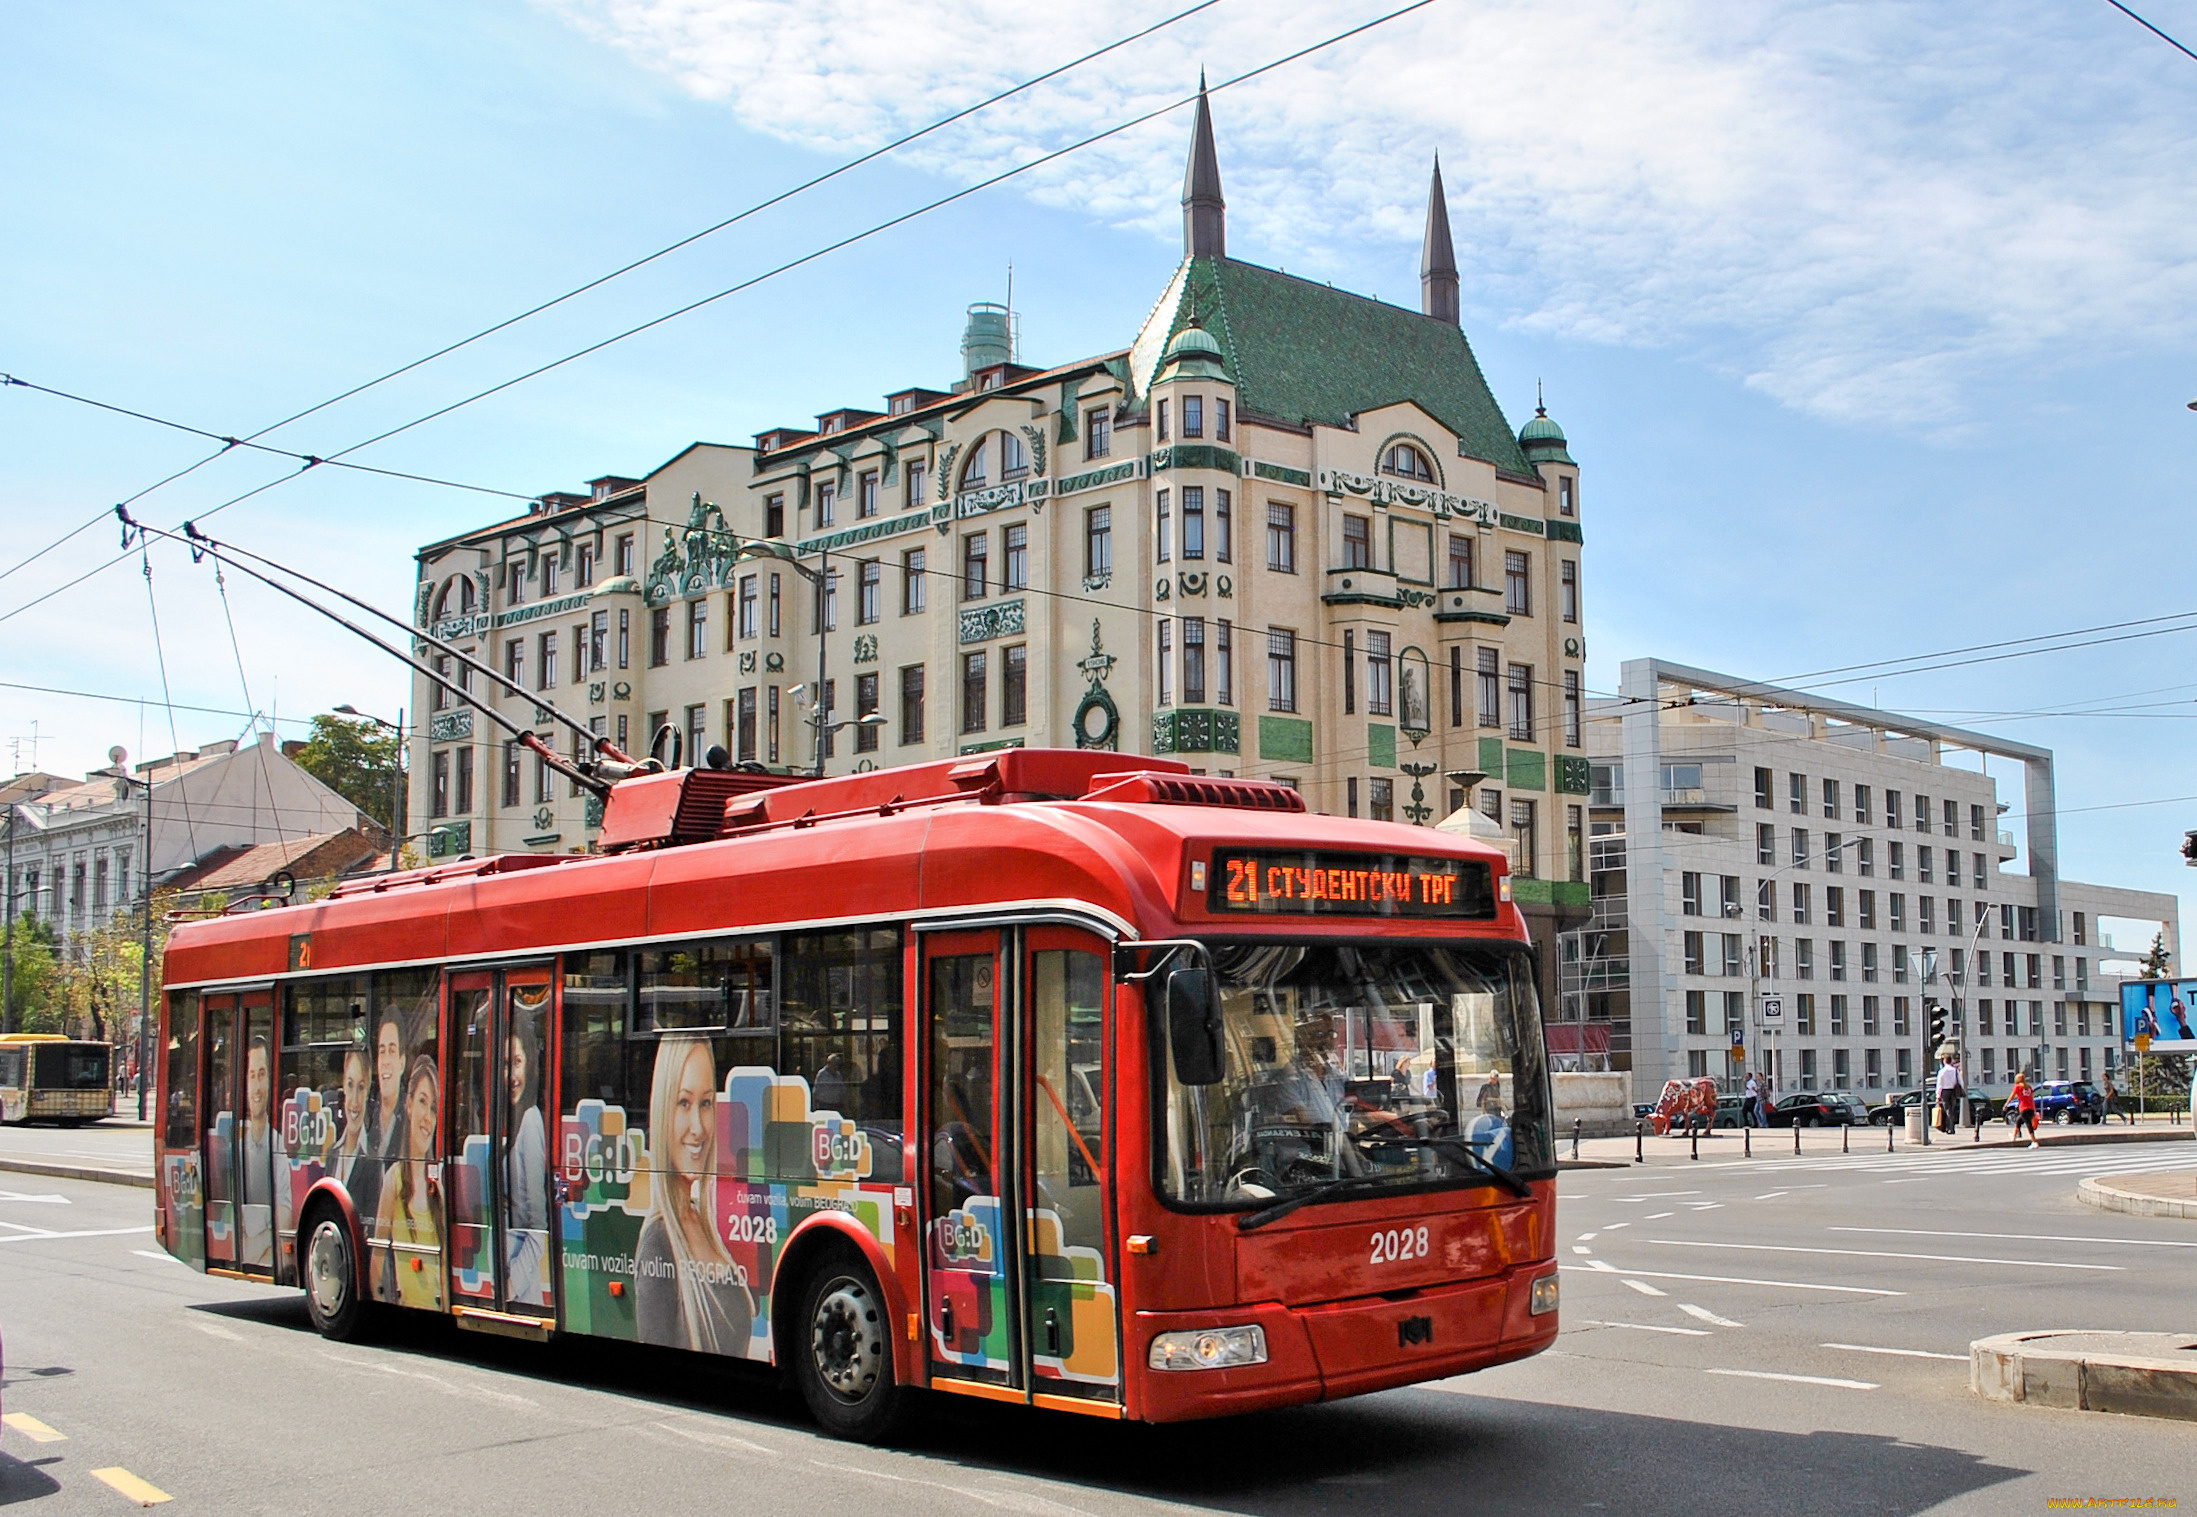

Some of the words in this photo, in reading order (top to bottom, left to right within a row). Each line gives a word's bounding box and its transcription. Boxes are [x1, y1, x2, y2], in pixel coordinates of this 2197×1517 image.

[1227, 860, 1257, 901] 21
[1267, 866, 1411, 902] СТУДЕНТСКИ
[1419, 874, 1457, 904] ТРГ
[1734, 1030, 1741, 1043] P
[2138, 1019, 2146, 1031] P
[288, 1111, 327, 1146] BG:D
[566, 1133, 636, 1184] BG:D
[819, 1133, 862, 1161] BG:D
[728, 1214, 778, 1244] 2028
[944, 1224, 983, 1249] BG:D
[1370, 1226, 1429, 1264] 2028
[562, 1246, 599, 1271] čuvam
[641, 1256, 676, 1280] volim
